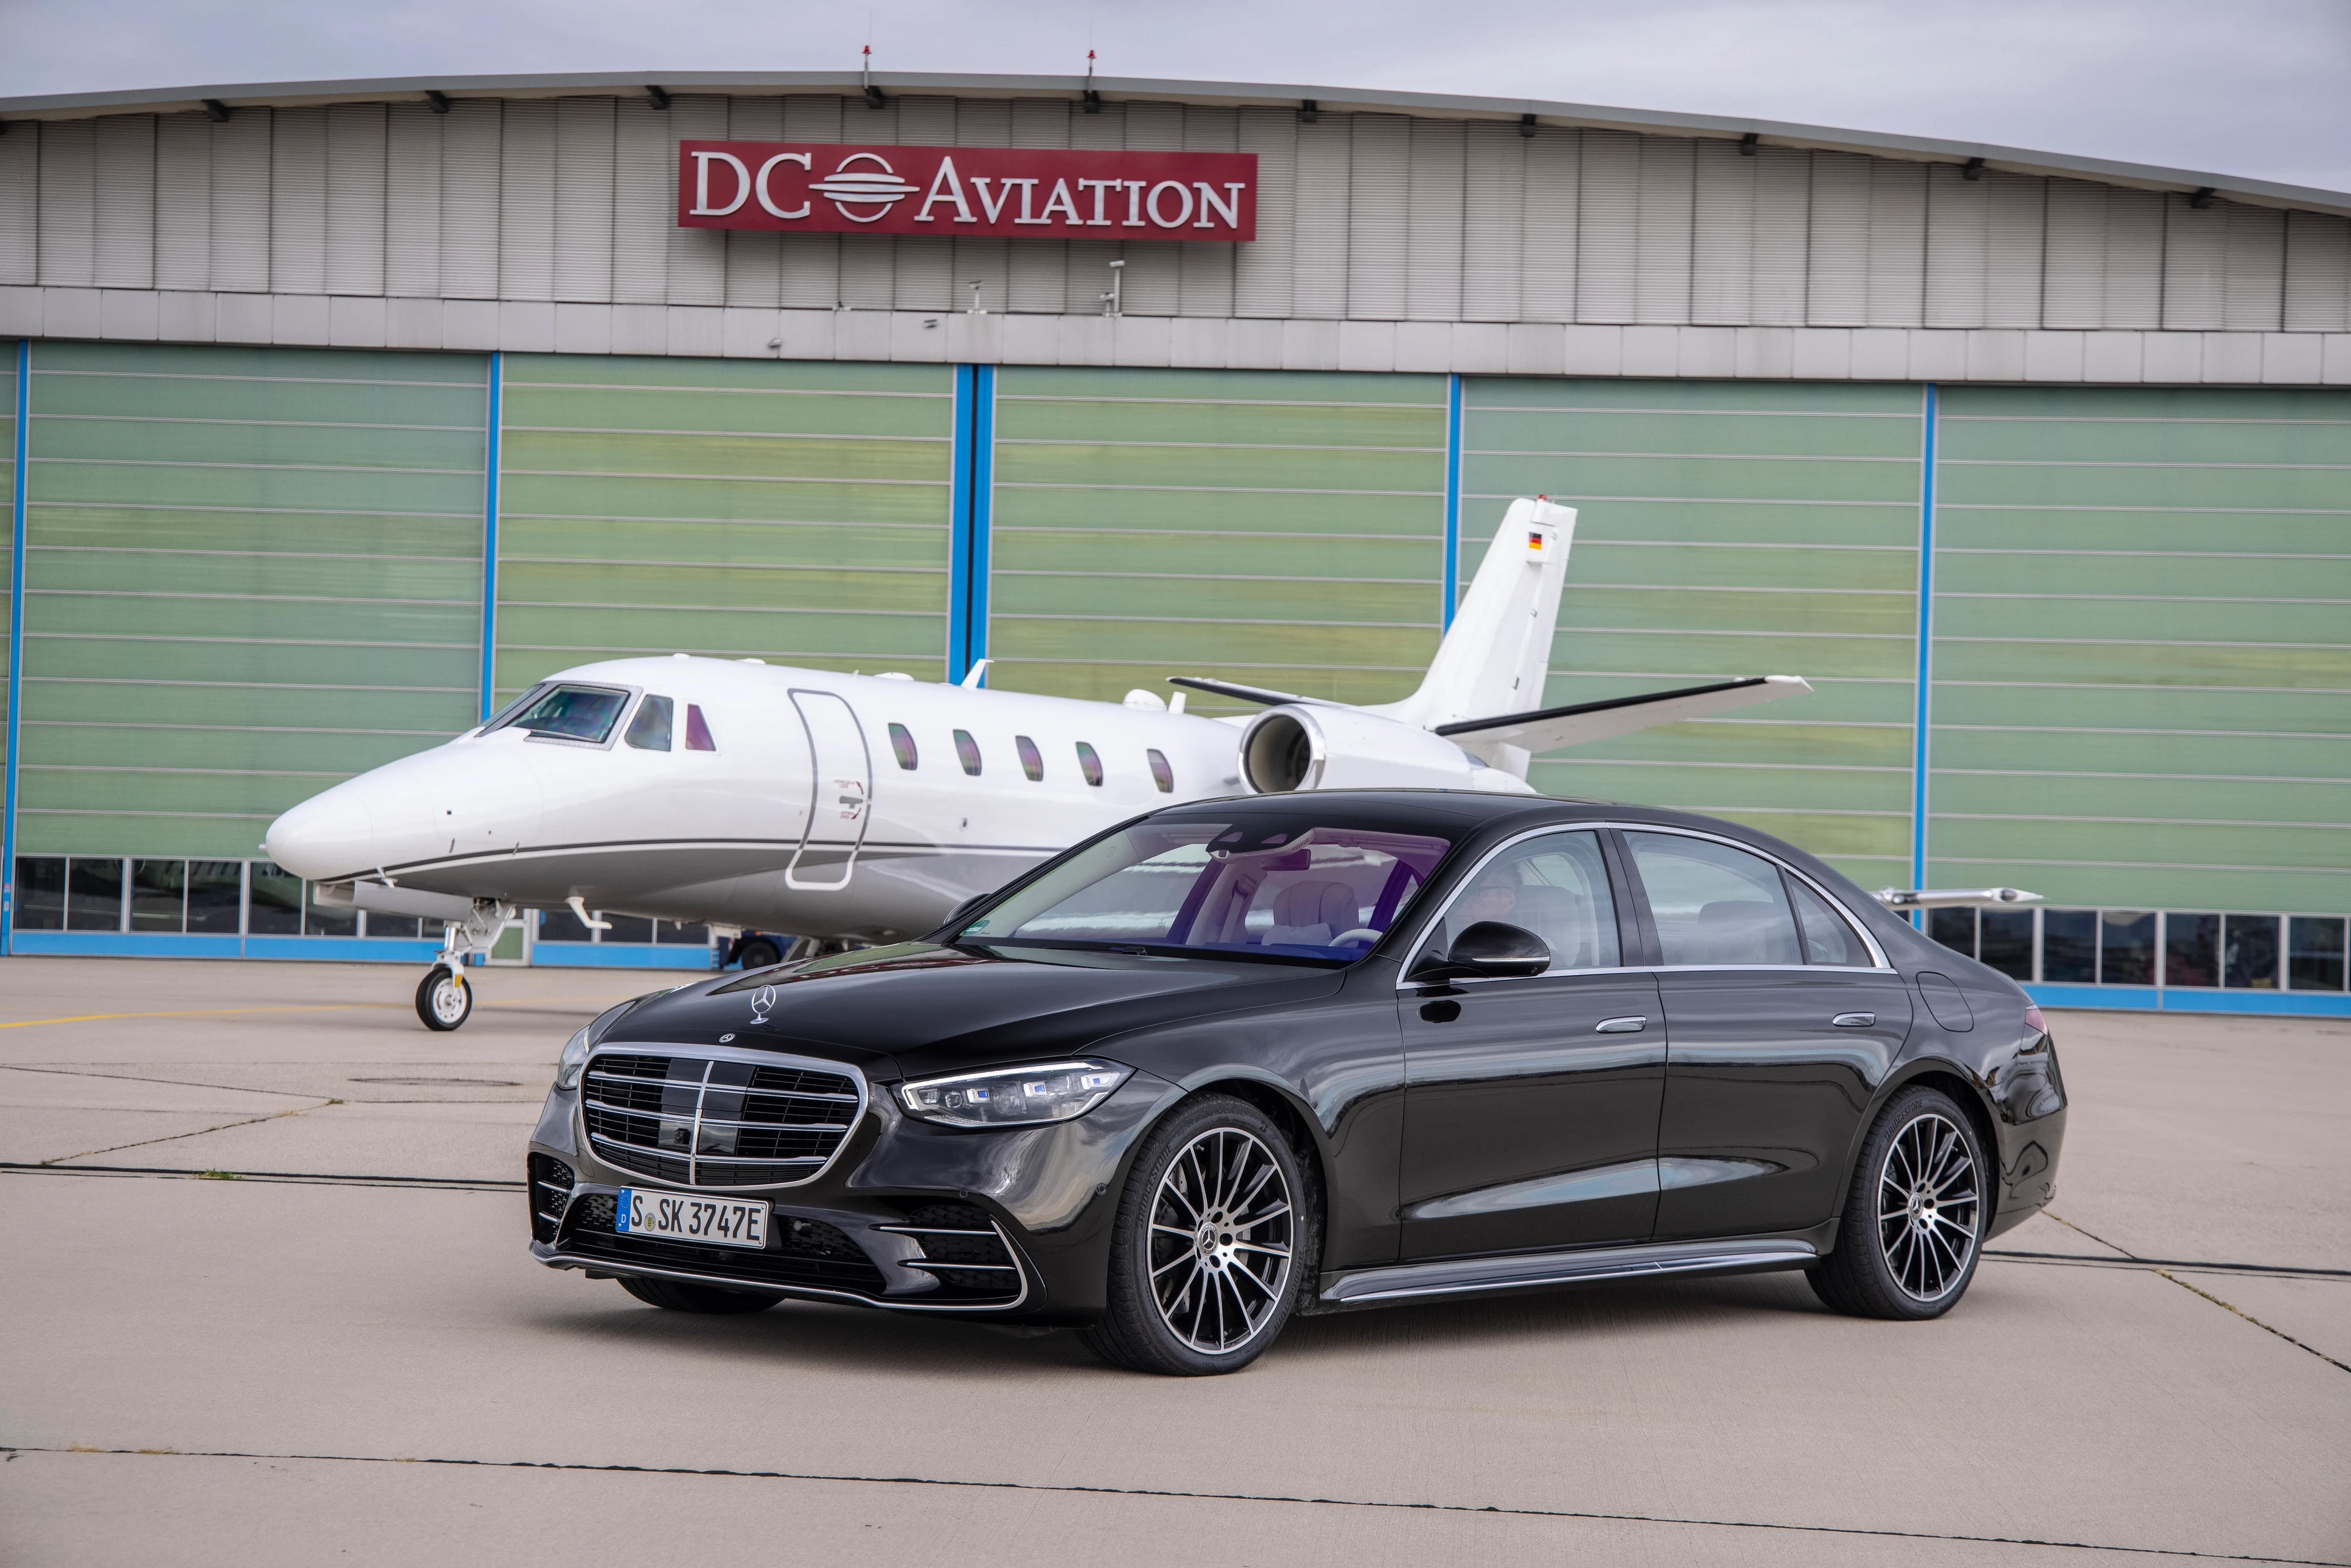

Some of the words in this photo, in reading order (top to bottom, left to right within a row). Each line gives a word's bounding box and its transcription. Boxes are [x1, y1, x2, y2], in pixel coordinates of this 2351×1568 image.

[689, 151, 812, 220] DC
[913, 156, 1246, 228] AVIATION
[1884, 1100, 1922, 1141] BRIDGESTONE
[621, 1214, 626, 1223] D
[631, 1195, 643, 1227] S
[658, 1198, 684, 1232] SK
[689, 1202, 761, 1241] 3747E
[1136, 1145, 1172, 1231] BRIDGESTONE
[1272, 1247, 1305, 1334] BRIDGESTONE
